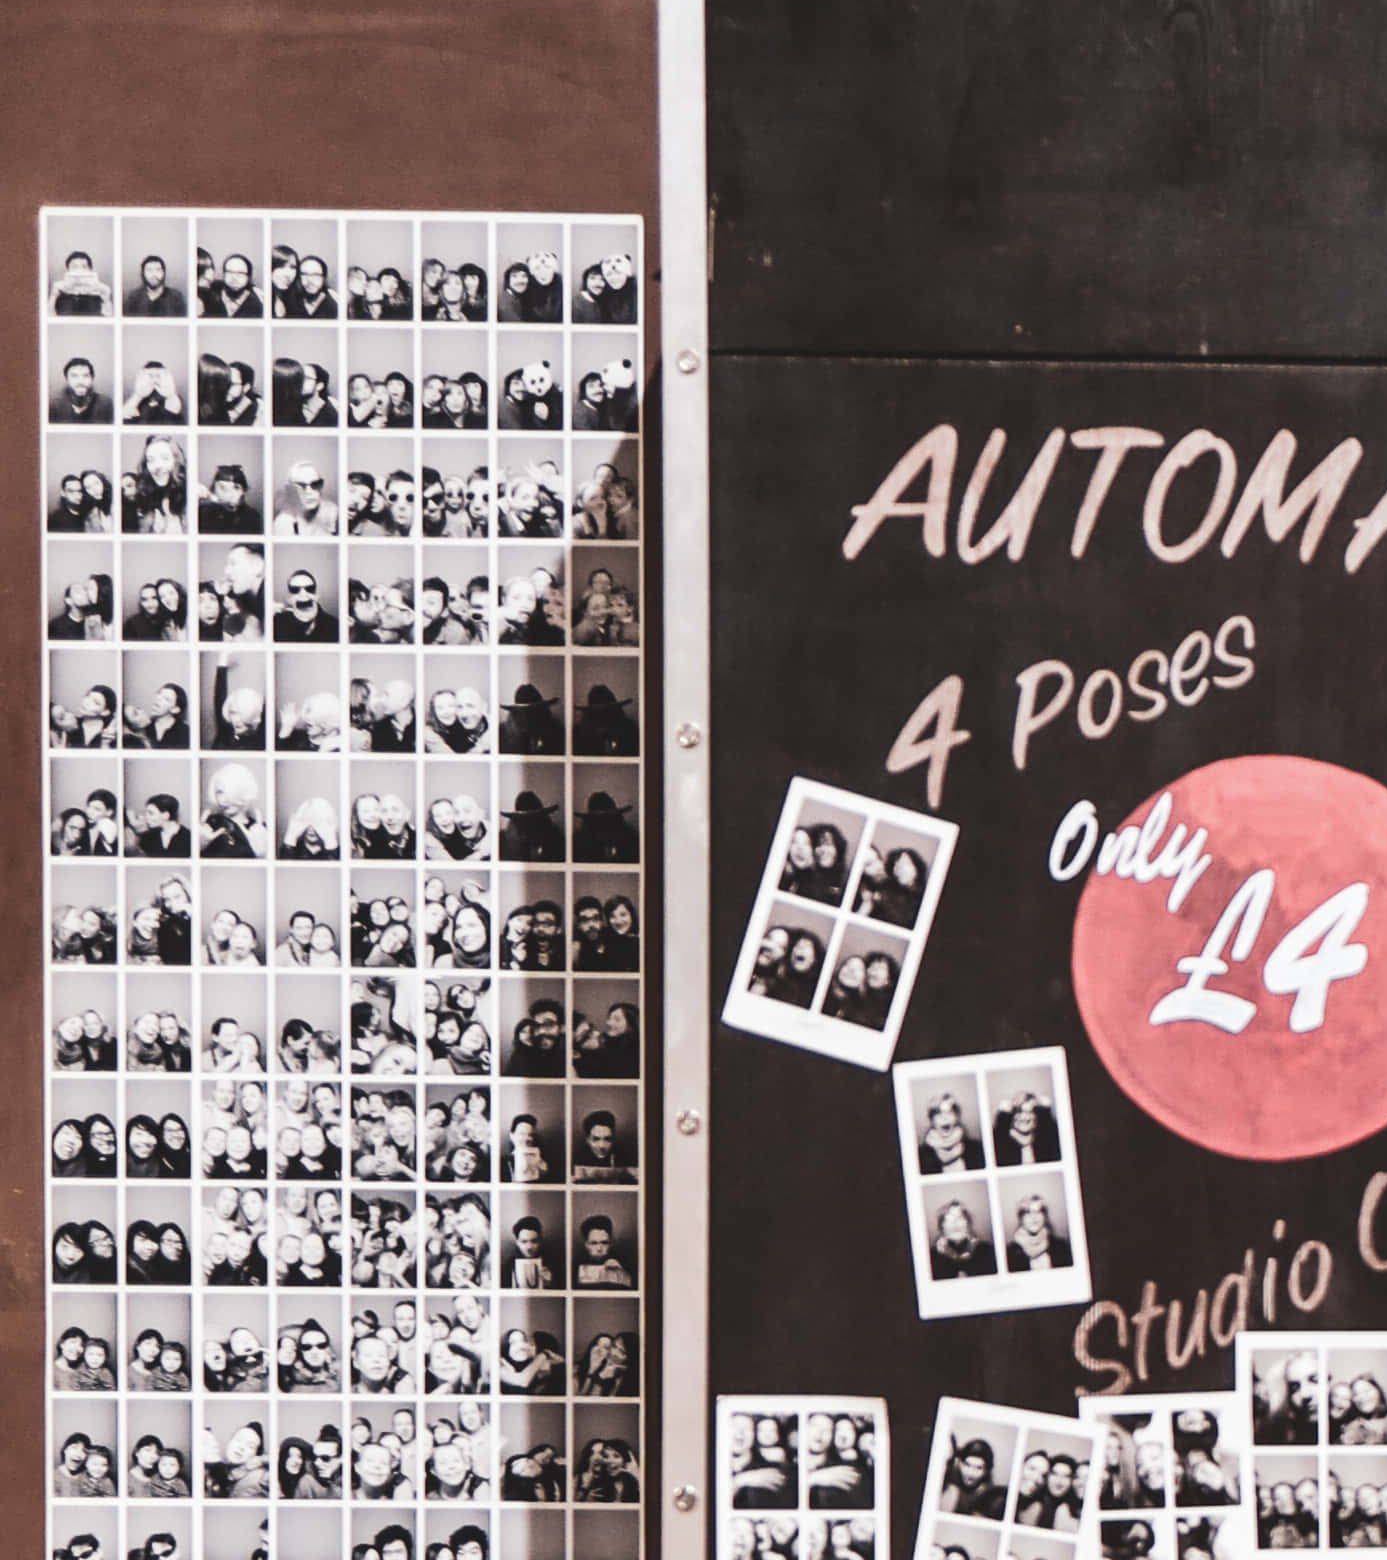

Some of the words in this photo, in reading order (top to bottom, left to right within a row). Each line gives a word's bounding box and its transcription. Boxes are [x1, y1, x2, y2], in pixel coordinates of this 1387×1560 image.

[885, 675, 971, 808] 4
[1048, 791, 1211, 913] Only
[1148, 869, 1371, 1035] £4
[1073, 1219, 1332, 1397] Studio
